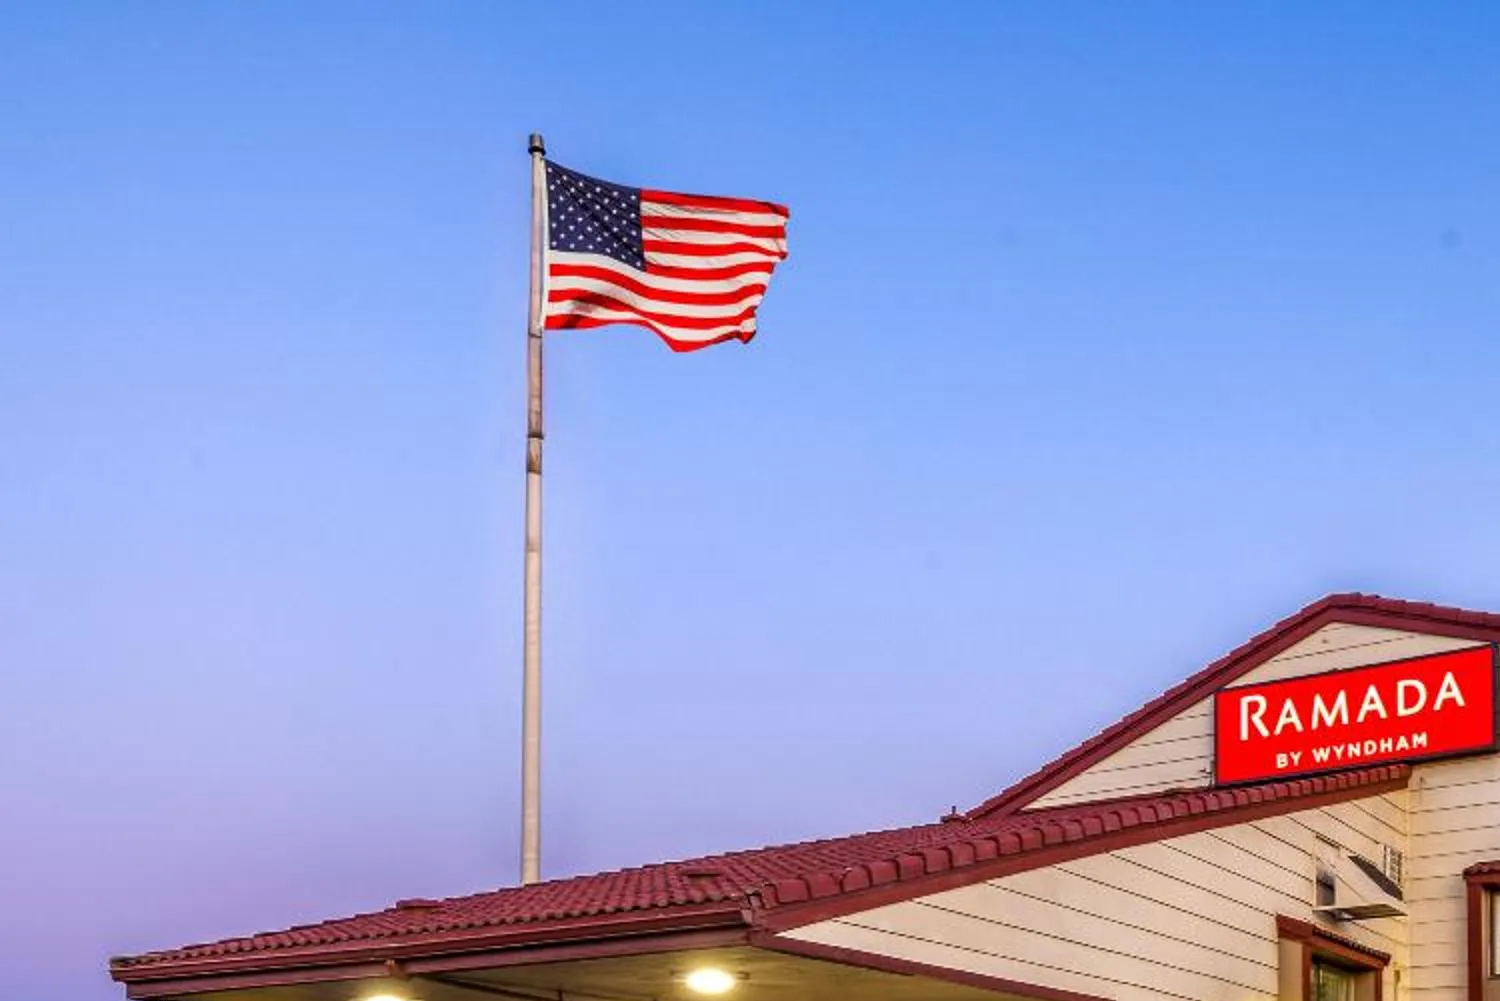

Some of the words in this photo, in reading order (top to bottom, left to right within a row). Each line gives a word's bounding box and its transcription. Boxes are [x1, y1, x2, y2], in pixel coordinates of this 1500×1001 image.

[1240, 671, 1465, 741] RAMADA
[1276, 751, 1301, 768] BY
[1312, 732, 1428, 763] WYNDHAM
